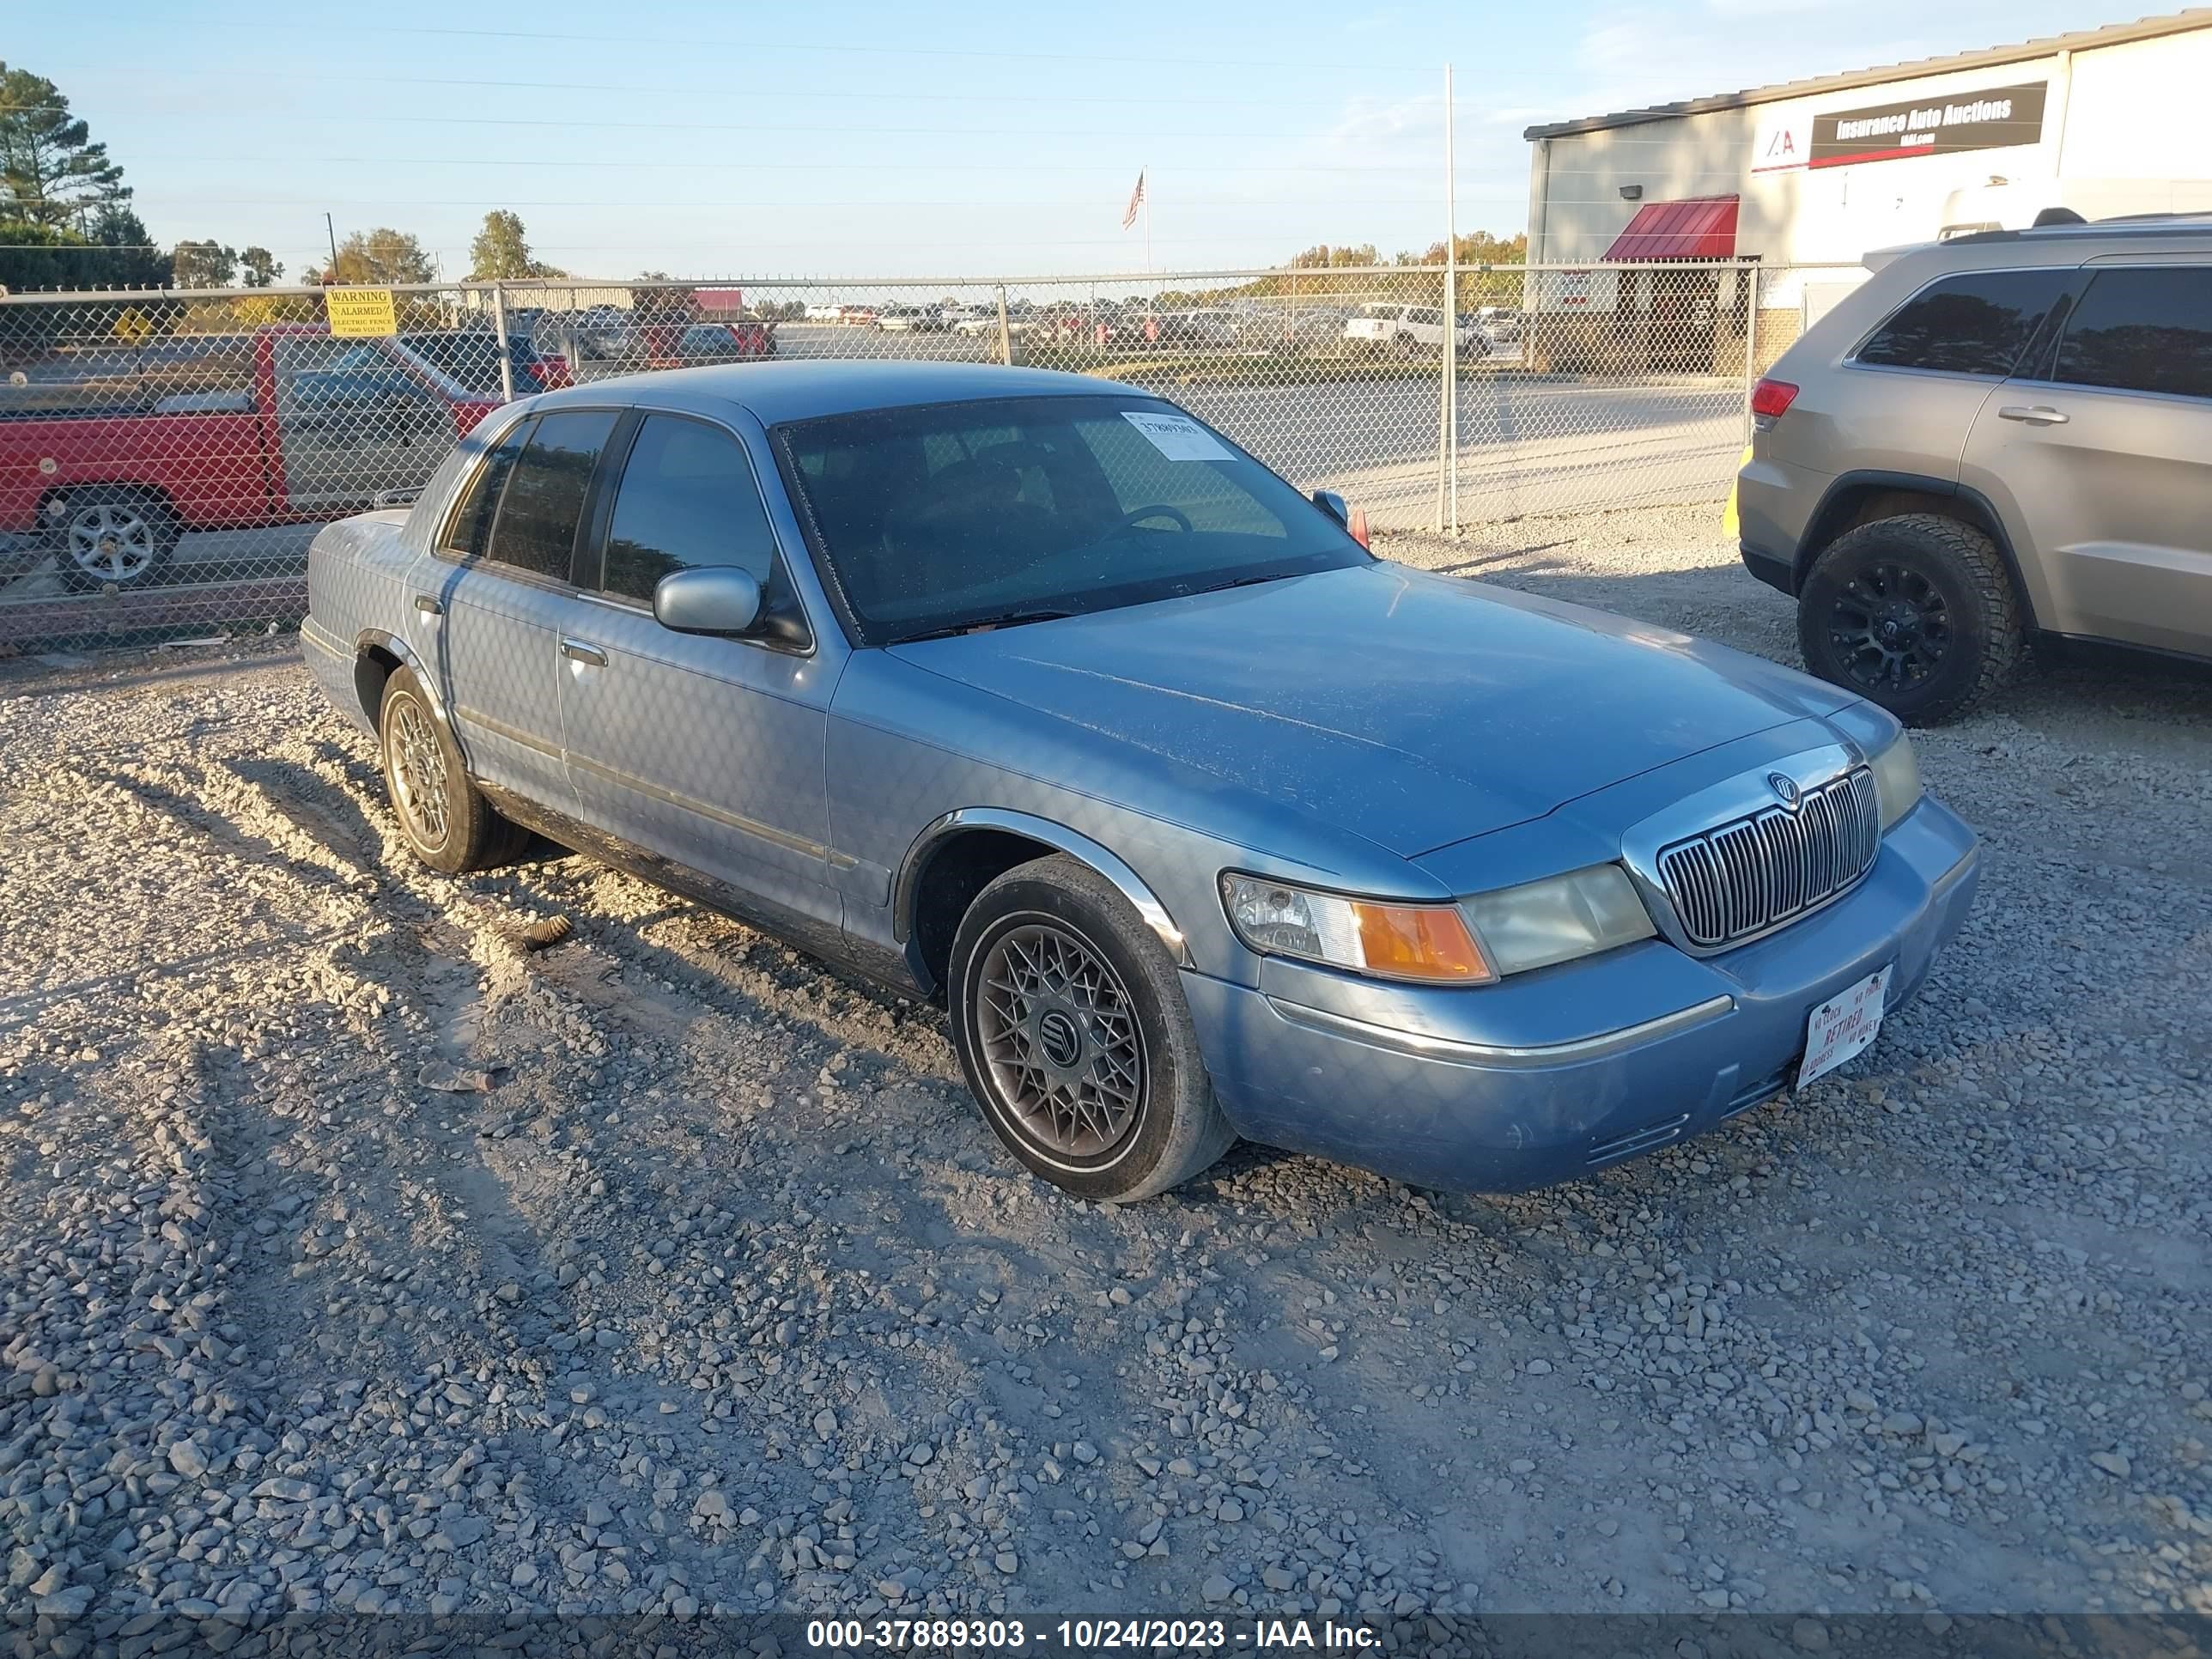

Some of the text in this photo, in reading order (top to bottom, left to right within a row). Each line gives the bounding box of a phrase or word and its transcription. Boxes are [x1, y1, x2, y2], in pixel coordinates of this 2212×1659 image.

[1836, 100, 2012, 140] Insurance Auto Auctions
[331, 291, 386, 301] WARNING
[340, 307, 383, 316] ALARMED
[1854, 990, 1863, 1006] NO
[1814, 1006, 1842, 1031] NO CLOCK
[1823, 1008, 1863, 1047] RETIRED
[1848, 1018, 1879, 1045] NO MONEY
[1809, 1047, 1834, 1070] ADDRESS
